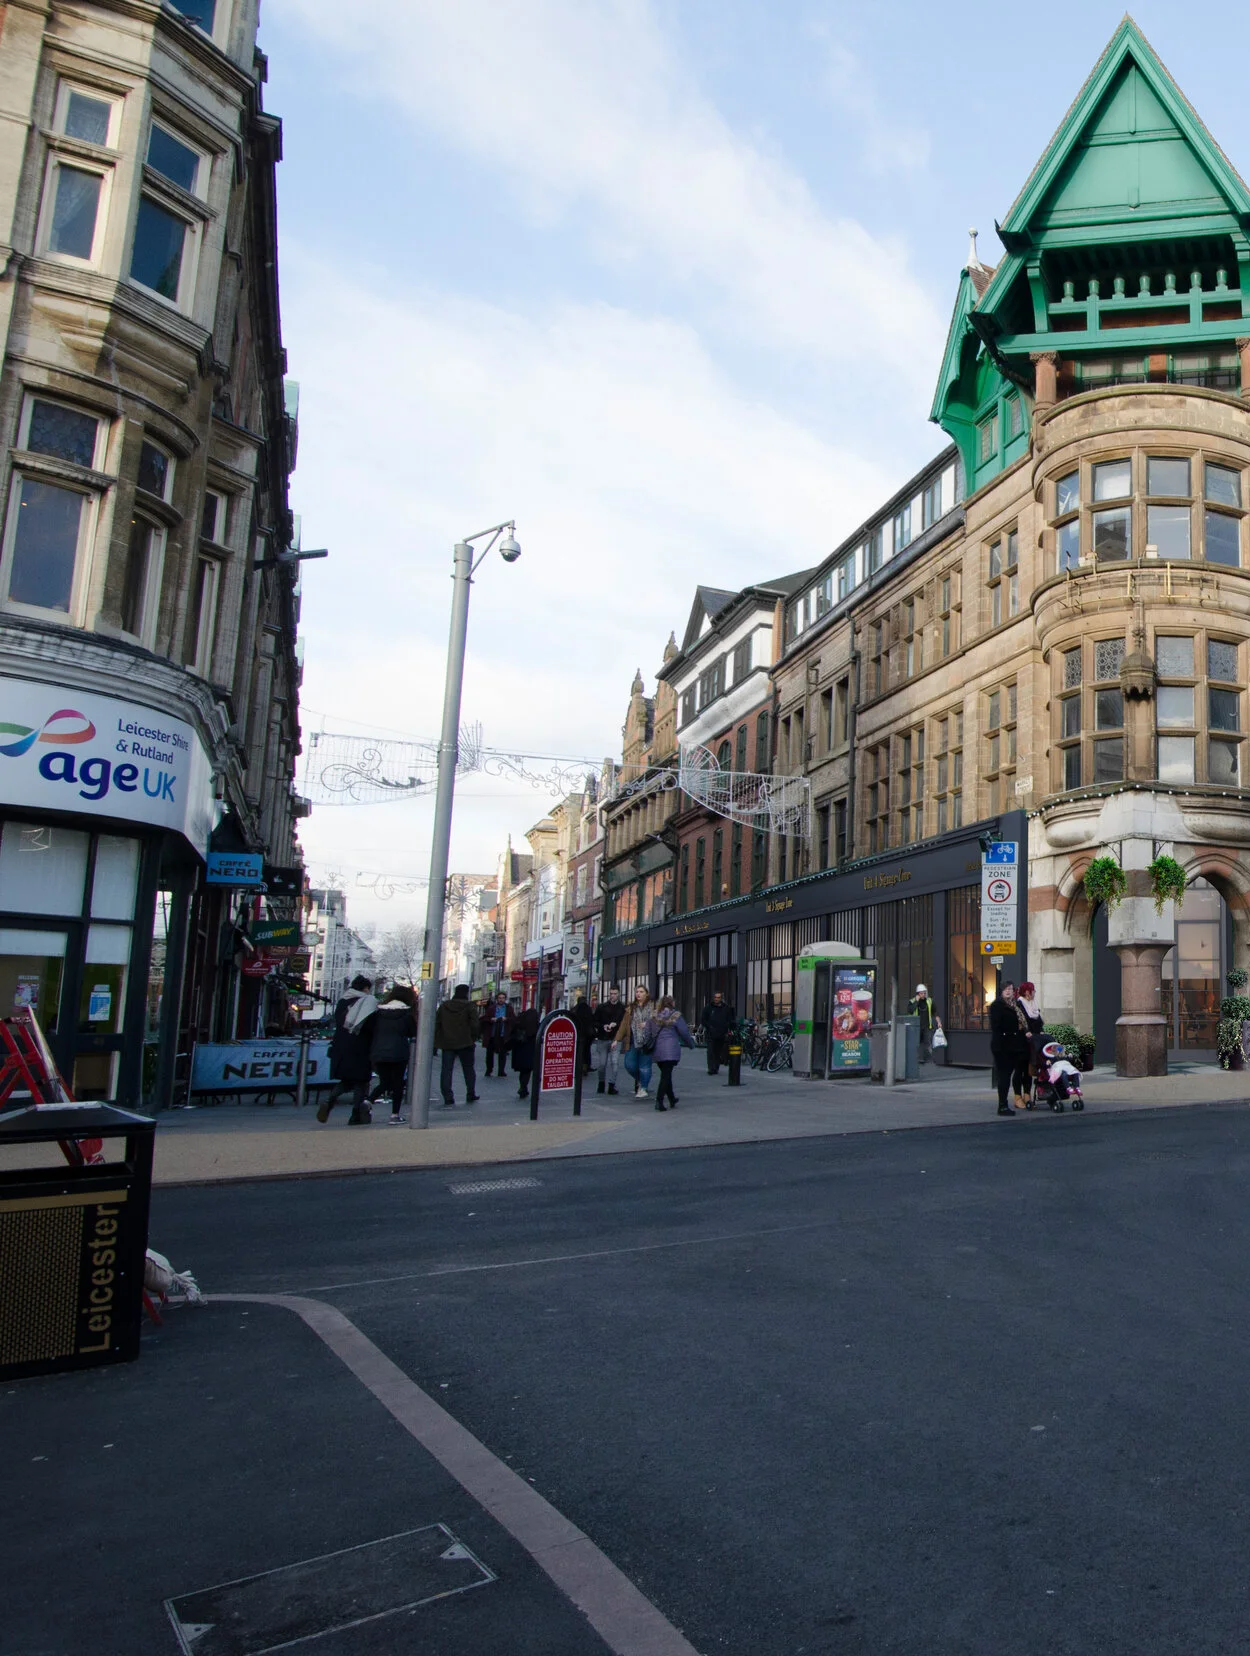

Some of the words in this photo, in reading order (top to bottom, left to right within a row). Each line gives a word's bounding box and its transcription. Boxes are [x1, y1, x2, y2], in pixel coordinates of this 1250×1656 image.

[118, 718, 171, 744] Leicester
[172, 733, 189, 751] Shire
[116, 739, 128, 754] &
[131, 742, 174, 764] Rutland
[209, 867, 259, 877] NERO
[254, 927, 295, 941] SUBWAY
[843, 1040, 859, 1050] STAR
[222, 1060, 317, 1080] NERO
[79, 1204, 120, 1354] Leicester
